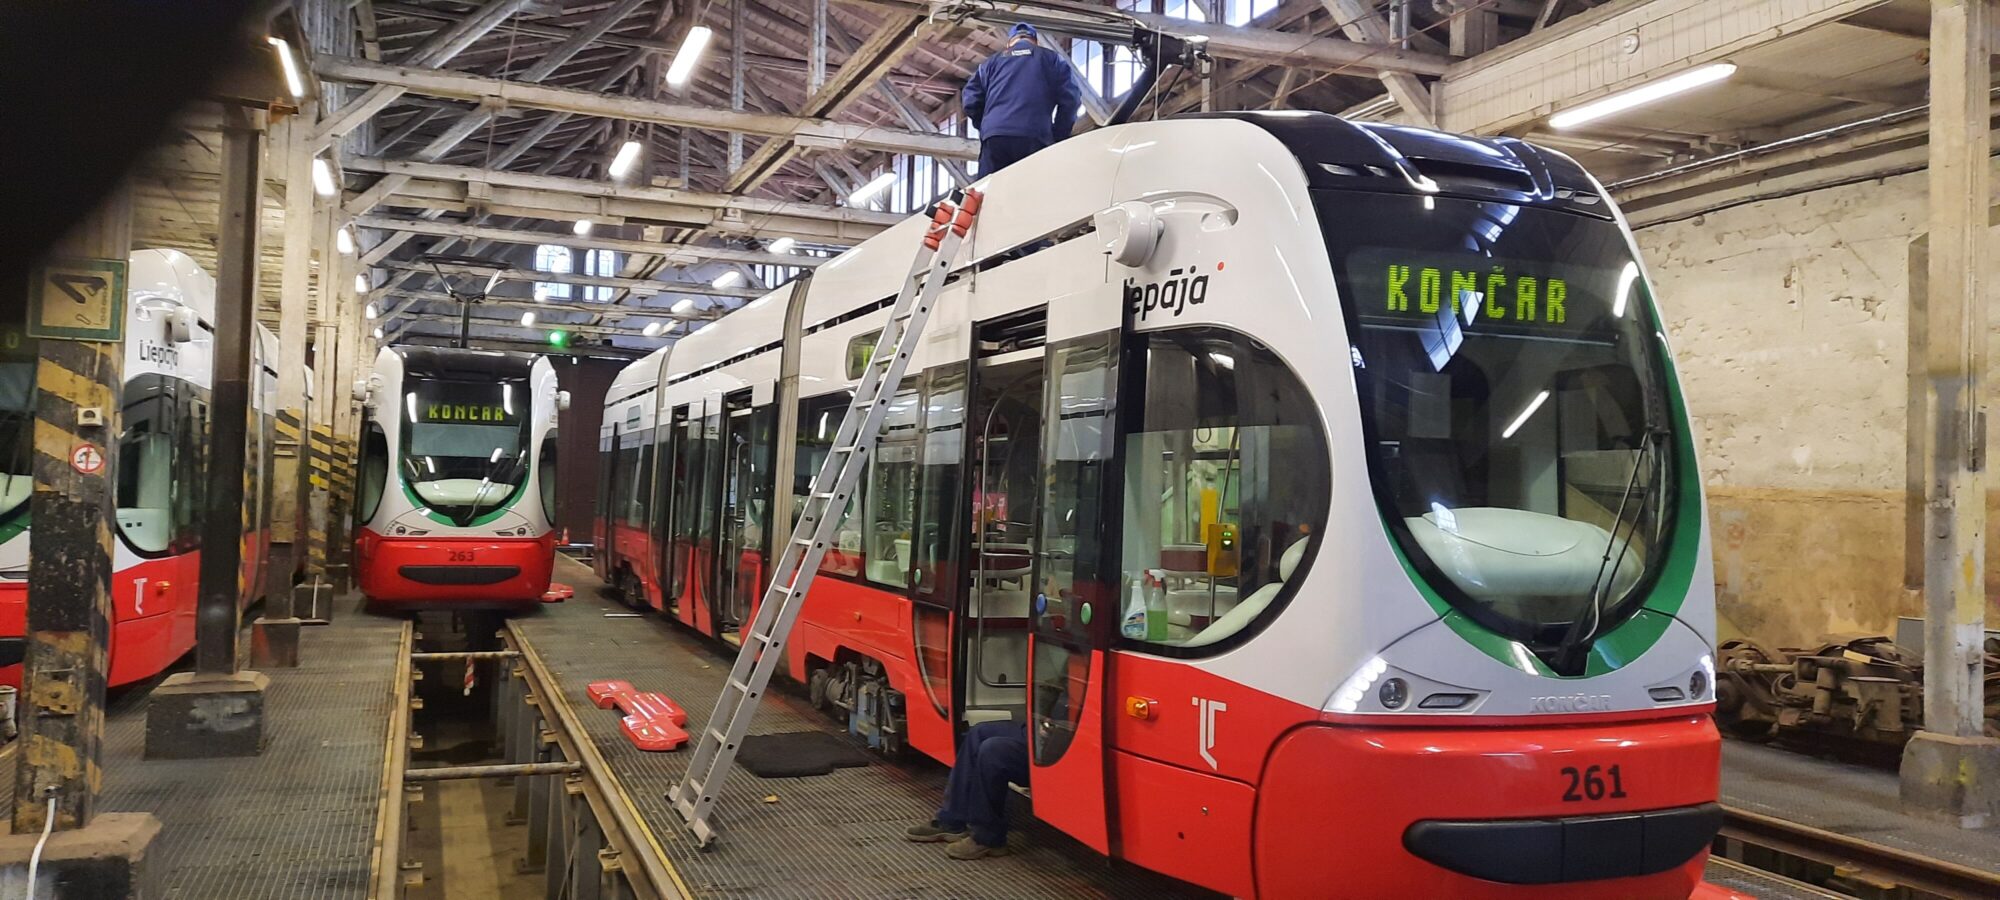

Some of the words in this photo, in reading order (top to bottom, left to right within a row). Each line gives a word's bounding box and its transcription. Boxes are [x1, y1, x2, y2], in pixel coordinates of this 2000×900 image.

[1387, 264, 1567, 323] KONČAR
[448, 550, 475, 562] 263
[1560, 763, 1627, 803] 261
